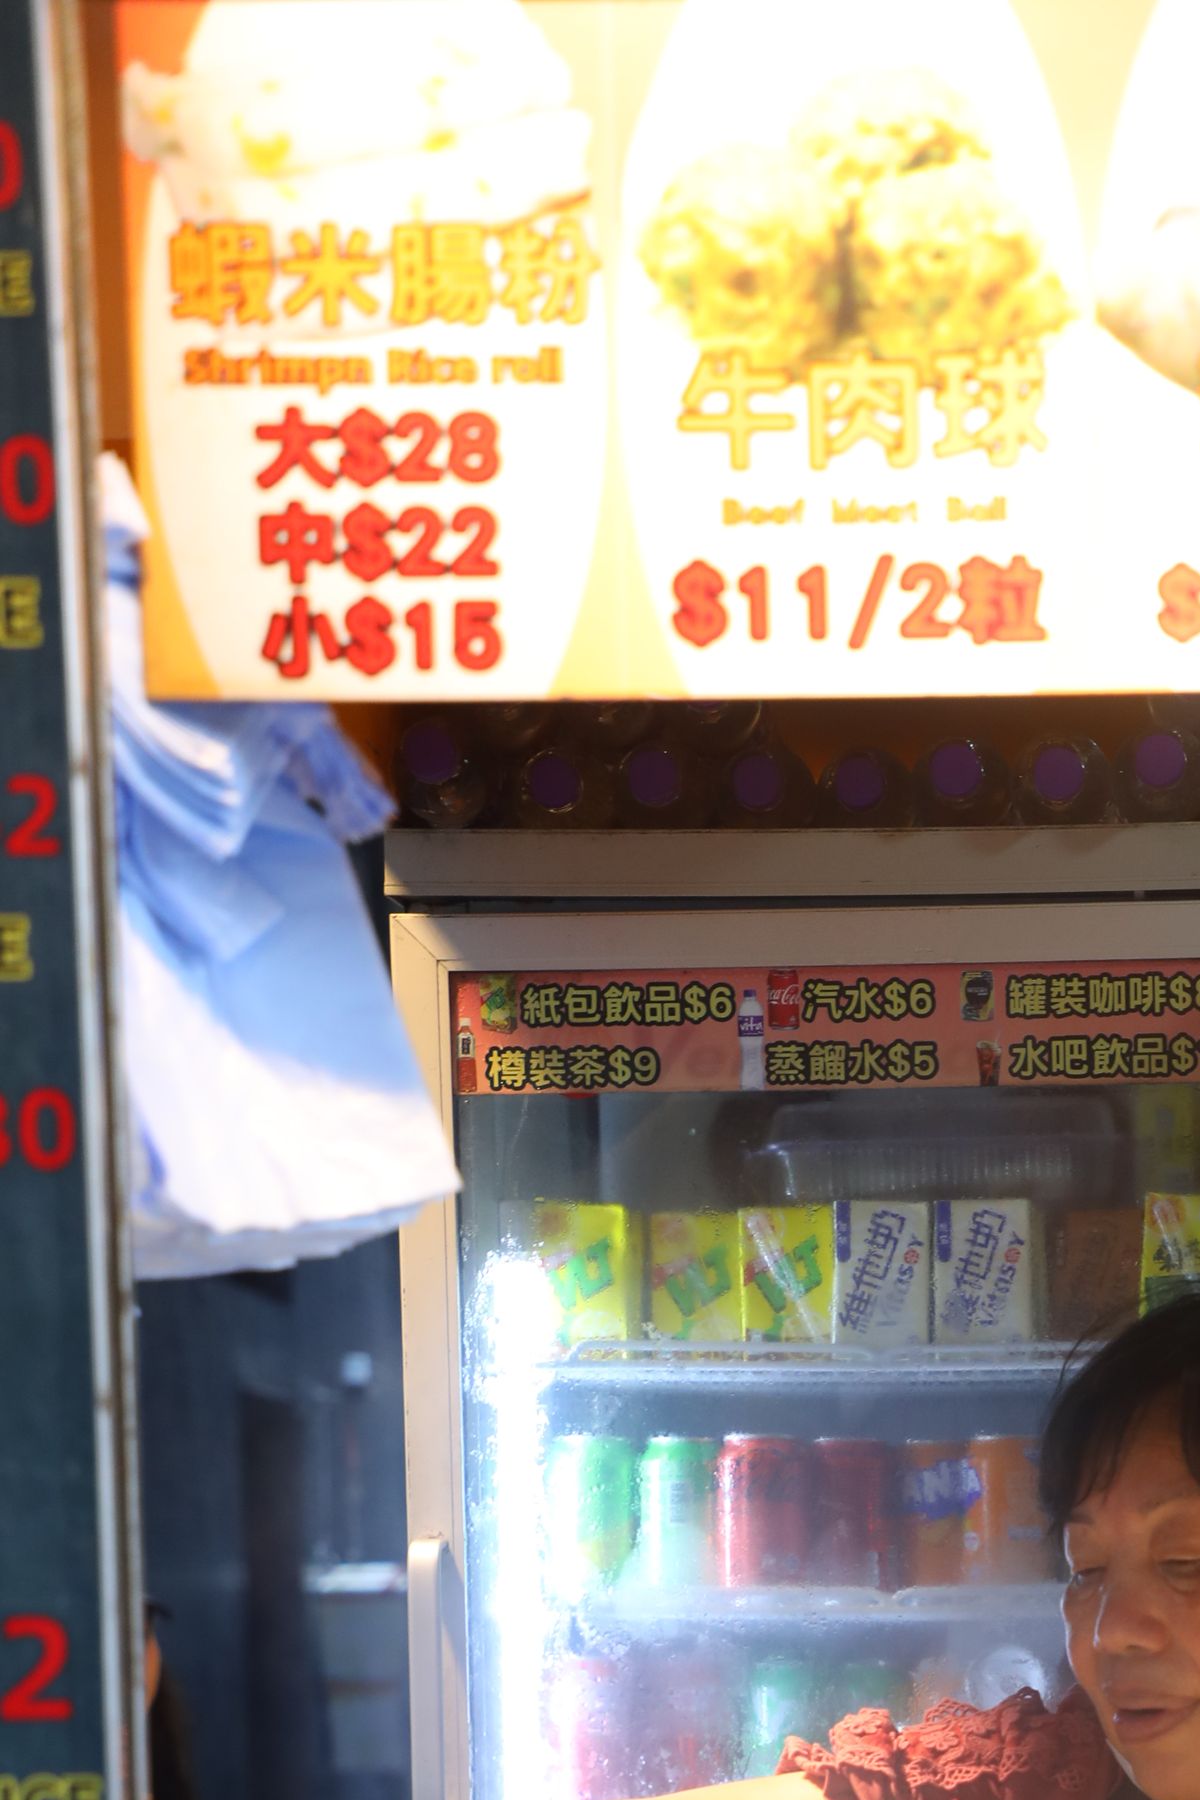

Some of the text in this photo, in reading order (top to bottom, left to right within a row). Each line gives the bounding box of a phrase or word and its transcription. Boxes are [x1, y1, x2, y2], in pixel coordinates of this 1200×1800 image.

[169, 219, 603, 326] 蝦米腸粉
[388, 347, 478, 386] Rice
[491, 345, 563, 385] roll
[255, 405, 499, 489] 大$28
[676, 347, 1048, 471] 牛肉球
[258, 501, 499, 586] 中$22
[262, 595, 504, 679] 小$15
[521, 981, 736, 1028] 紙包飲品$6
[802, 977, 936, 1023] 汽水$6
[764, 1039, 940, 1086] 蒸餾水$5
